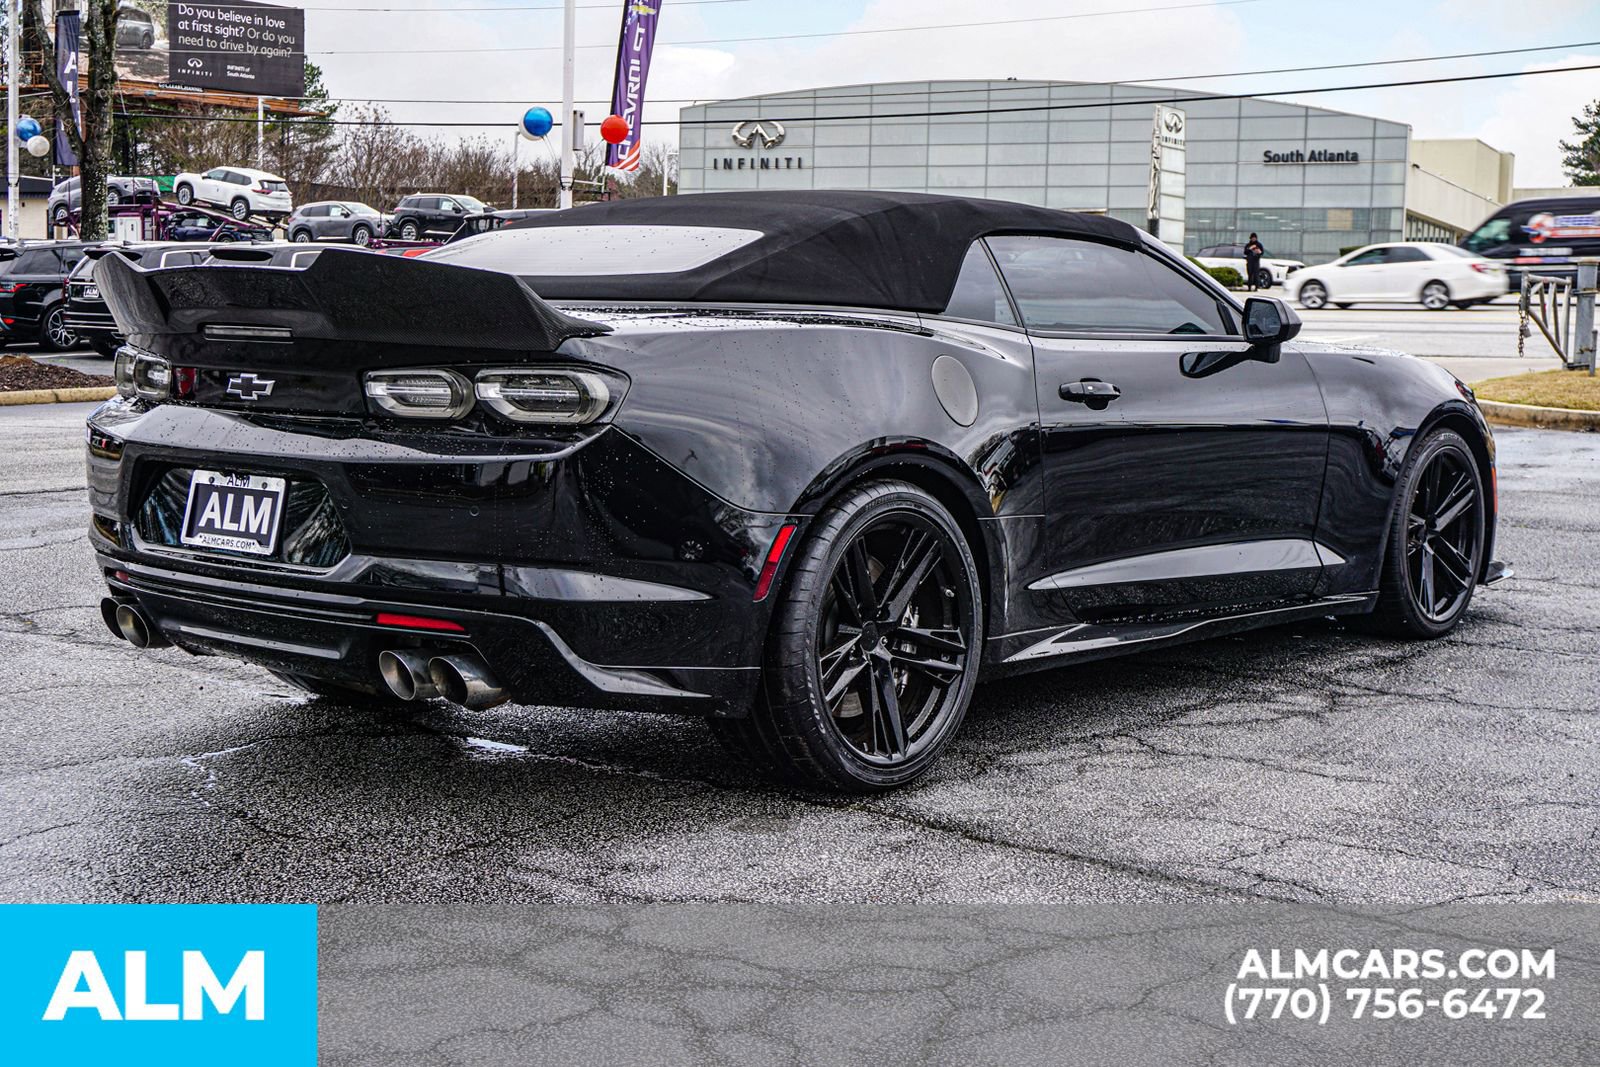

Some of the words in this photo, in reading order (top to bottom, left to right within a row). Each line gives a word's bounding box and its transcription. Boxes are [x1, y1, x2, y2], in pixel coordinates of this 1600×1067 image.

[178, 4, 194, 15] Do
[196, 8, 215, 19] you
[218, 9, 252, 24] believe
[254, 14, 263, 25] in
[265, 16, 286, 29] love
[178, 20, 189, 30] at
[192, 19, 213, 34] first
[214, 25, 245, 38] sight?
[247, 27, 261, 39] Or
[262, 30, 275, 41] do
[277, 35, 295, 46] you
[178, 35, 204, 47] need
[206, 38, 218, 48] to
[220, 39, 244, 52] drive
[246, 42, 259, 56] by
[261, 46, 292, 58] again?
[178, 68, 213, 77] INFINITI
[713, 157, 802, 170] INFINITI
[1263, 149, 1304, 163] South
[1308, 149, 1359, 162] Atlanta
[227, 474, 251, 488] ALM
[198, 491, 273, 535] ALM
